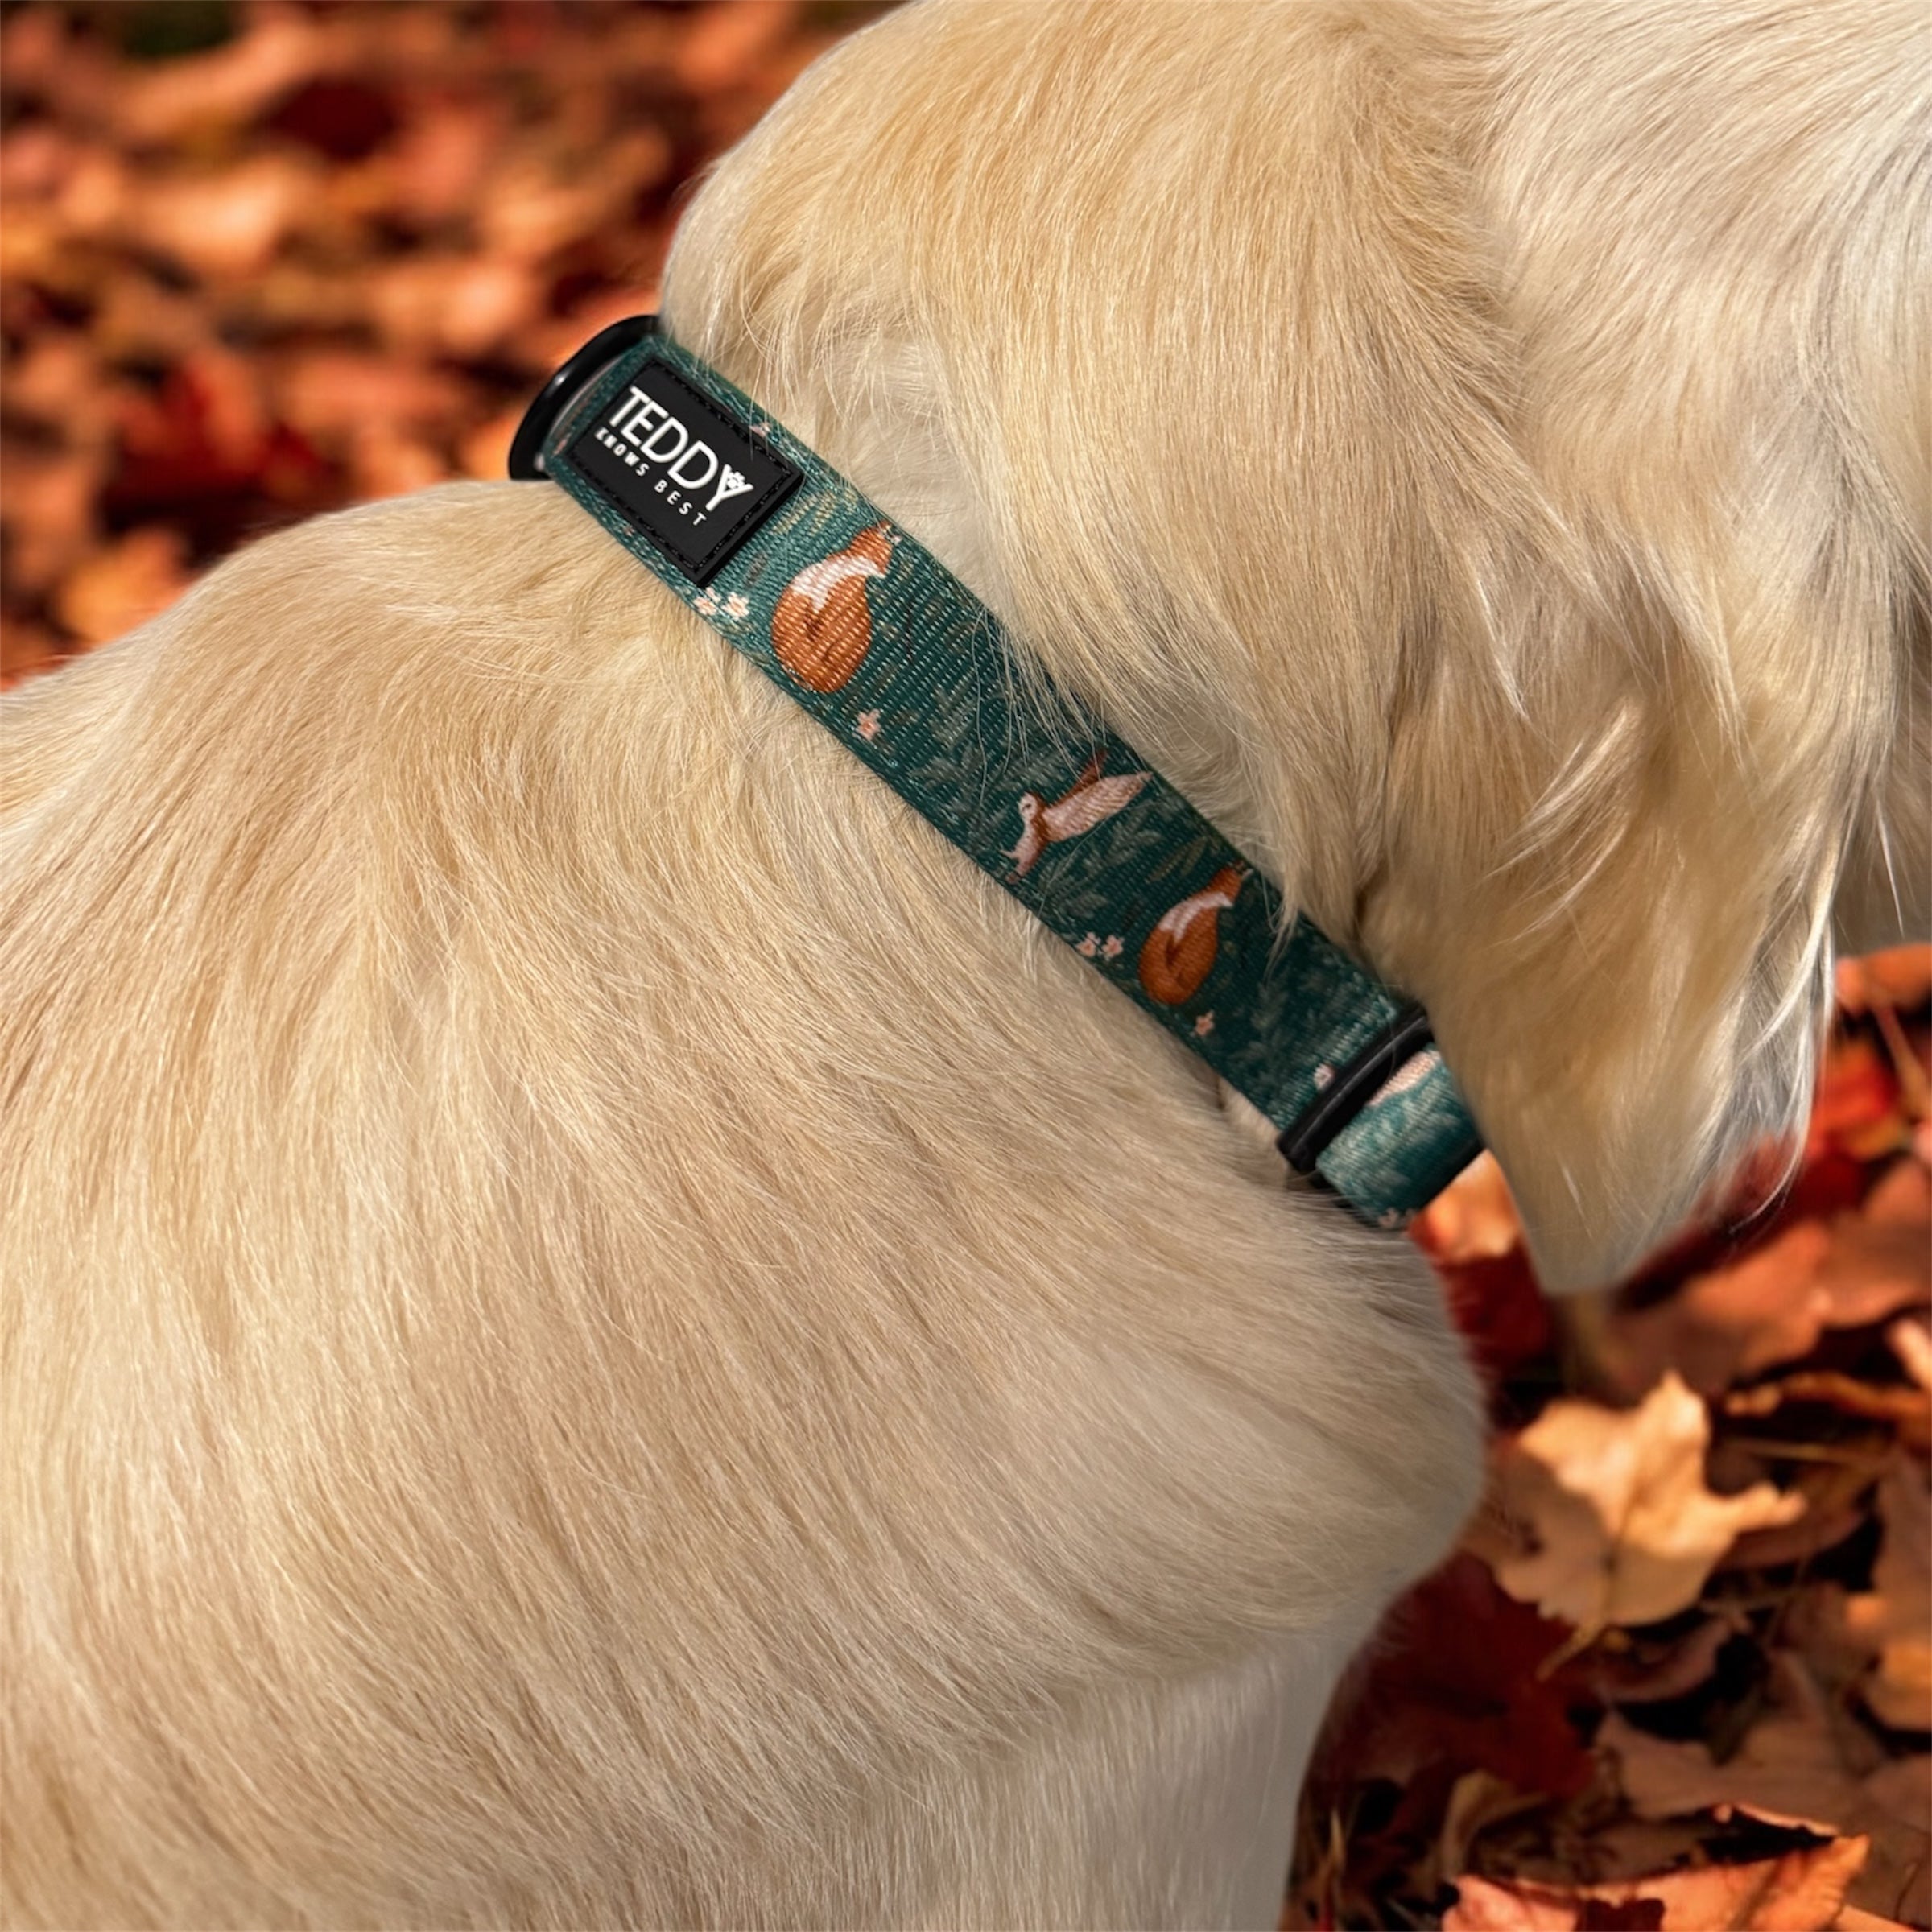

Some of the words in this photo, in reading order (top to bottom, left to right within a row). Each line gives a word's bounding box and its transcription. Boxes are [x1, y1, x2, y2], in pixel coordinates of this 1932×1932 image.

[595, 427, 650, 476] KNOWS
[654, 479, 707, 526] BEST
[609, 386, 753, 511] TEDDY
